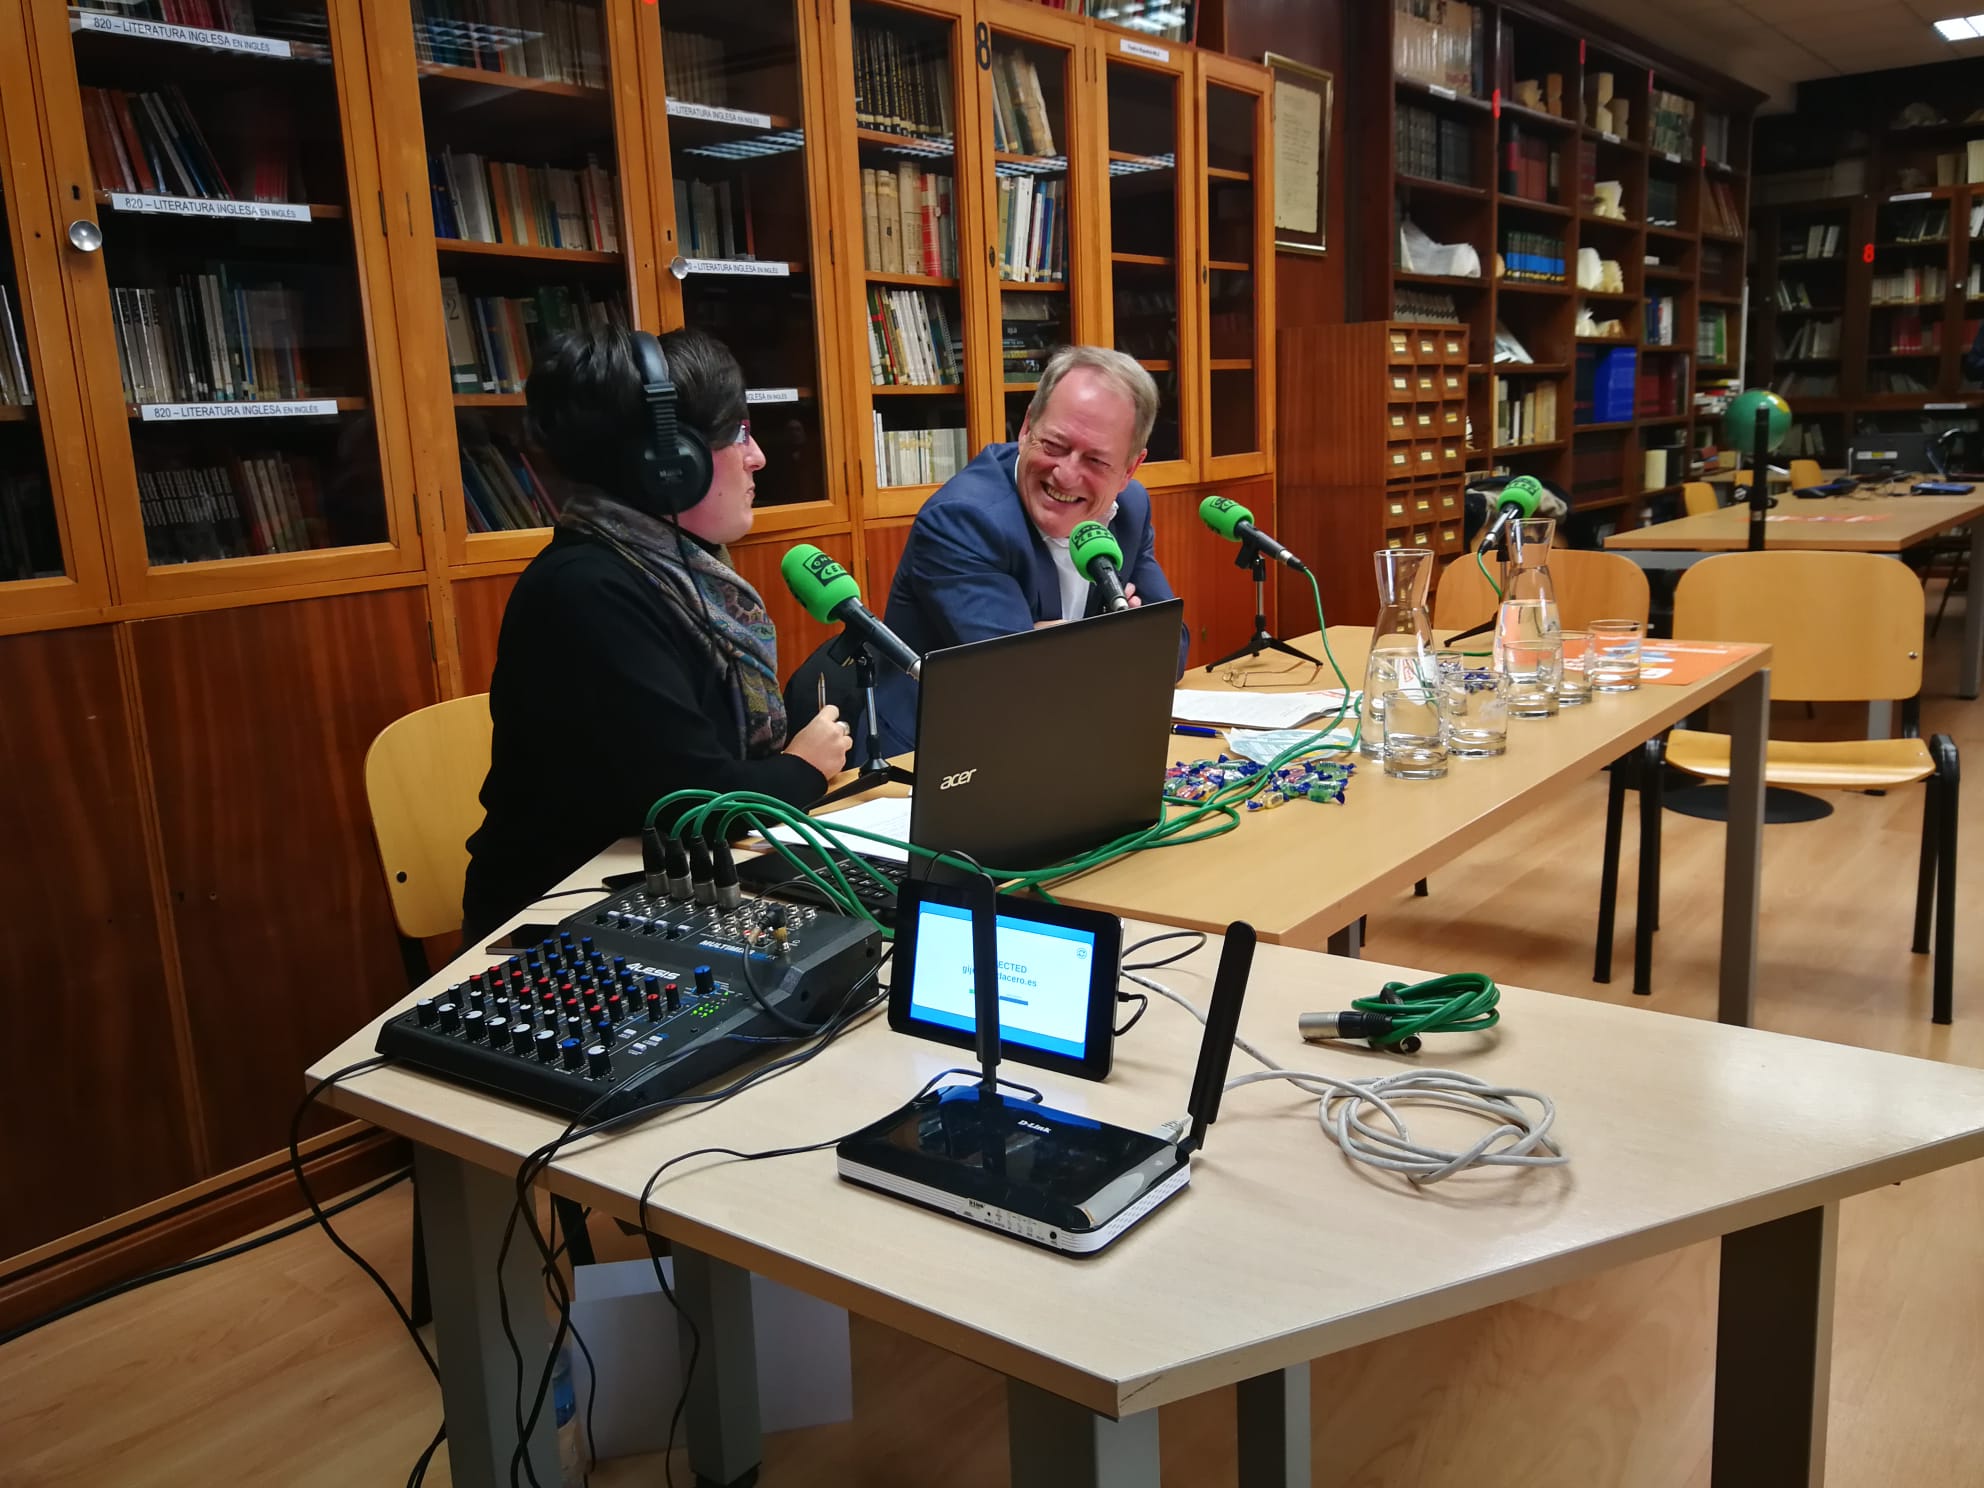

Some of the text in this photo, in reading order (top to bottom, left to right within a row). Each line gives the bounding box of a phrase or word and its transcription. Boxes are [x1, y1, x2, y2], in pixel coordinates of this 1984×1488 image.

[94, 17, 111, 30] 820
[123, 21, 186, 40] LITERATURA
[188, 31, 231, 47] INGLESA
[232, 38, 243, 48] EN
[976, 21, 991, 71] 8
[125, 197, 143, 209] 820
[154, 200, 215, 214] LITERATURA
[217, 203, 259, 217] INGLESA
[260, 208, 271, 217] EN
[697, 262, 732, 272] LITERATURA
[733, 264, 757, 273] INGLESA
[154, 407, 171, 418] 820
[181, 405, 241, 417] LITERATURA
[242, 404, 282, 416] INGLESA
[283, 406, 293, 414] EN
[940, 768, 977, 790] acer
[626, 962, 680, 980] ALESIS
[998, 960, 1028, 974] ECTED
[1017, 1120, 1052, 1134] D-Link
